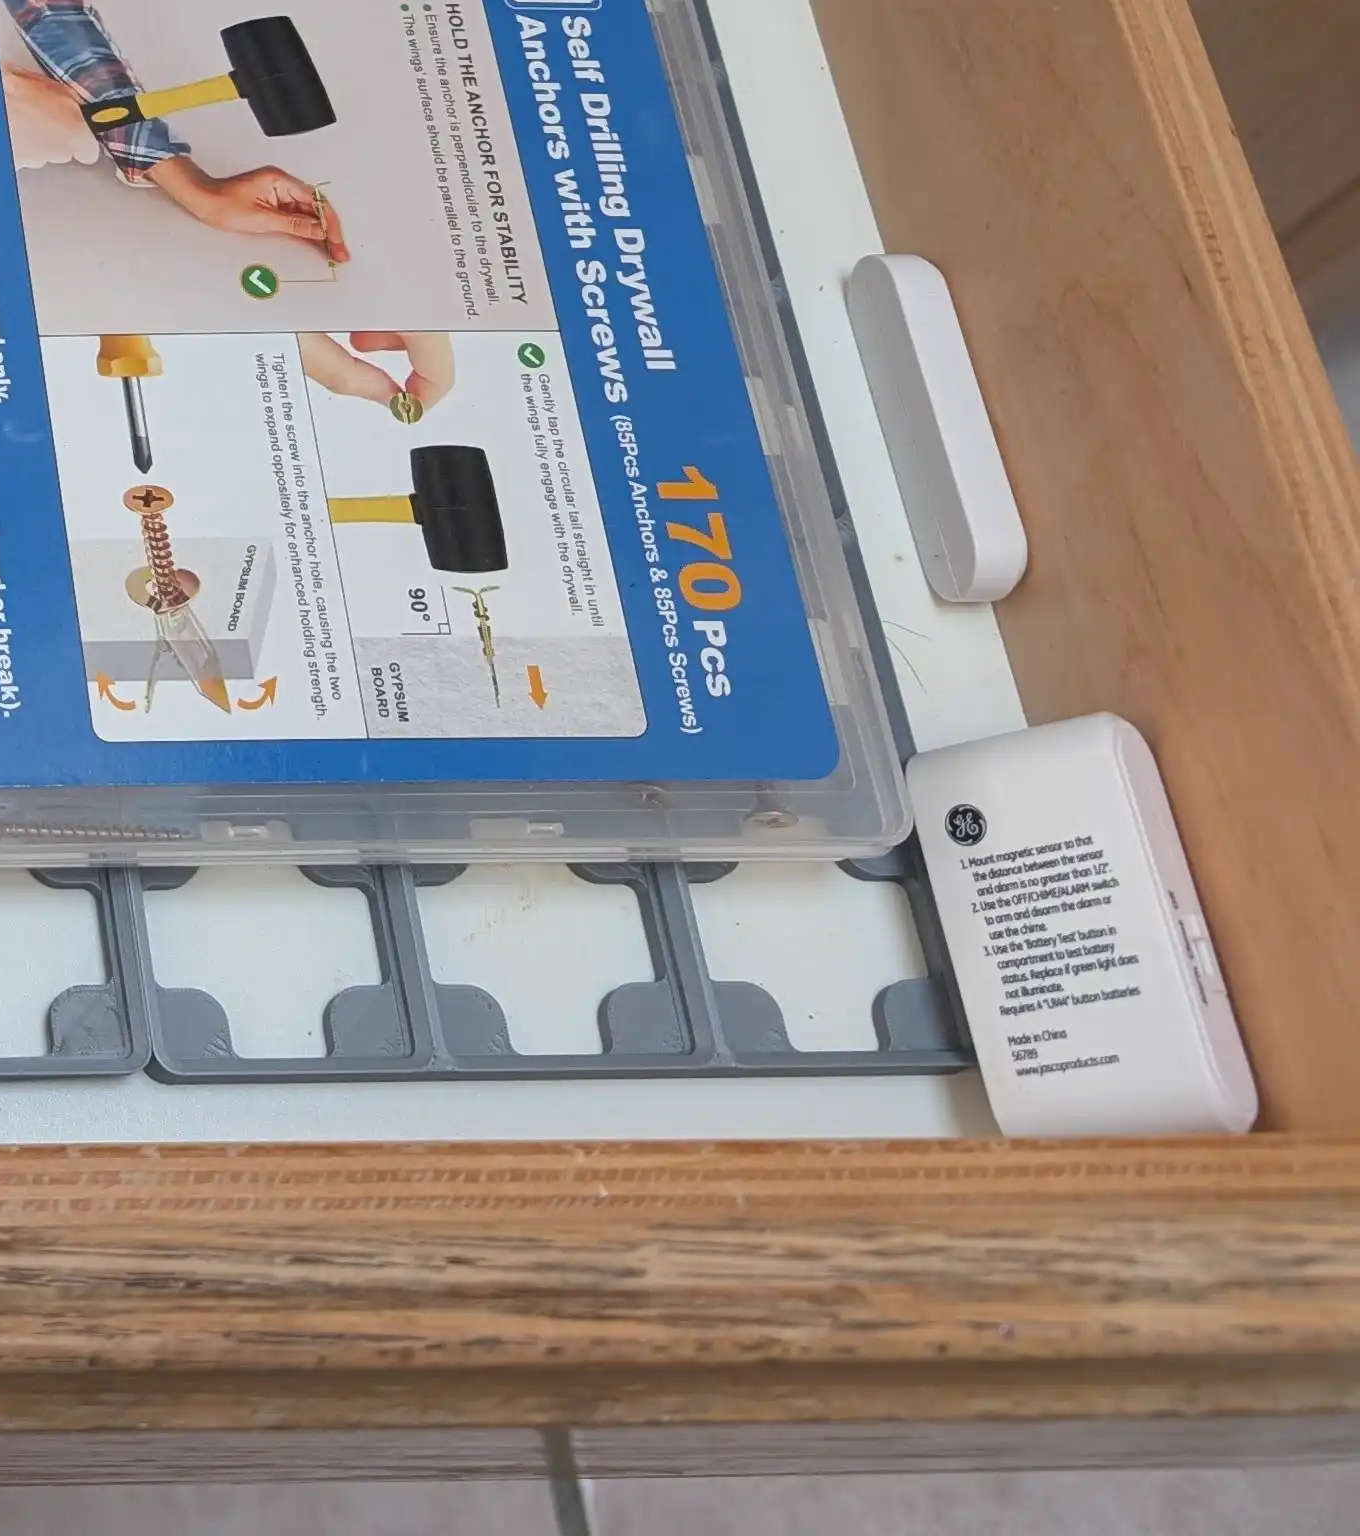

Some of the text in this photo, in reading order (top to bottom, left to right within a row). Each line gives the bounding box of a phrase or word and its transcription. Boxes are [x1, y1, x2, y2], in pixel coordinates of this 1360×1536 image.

[401, 12, 480, 321] The wings' surface should be parallel to the ground.
[423, 13, 500, 306] Ensure the anchor is perpendicular to the drywall.
[443, 2, 528, 305] HOLD THE ANCHOR FOR STABILITY
[514, 14, 627, 403] Anchors with Screws
[560, 15, 676, 370] Self Drilling Drywall
[253, 352, 328, 721] wings to expand oppositely for enhanced holding strength.
[269, 352, 342, 701] Tighten the screw into the anchor hole, causing the two
[519, 372, 584, 617] the wings fully engage with the drywall.
[536, 372, 605, 628] Gently tap the circular tail straight in until
[227, 544, 257, 632] GYPSUM BOARD
[406, 587, 431, 622] 90°
[607, 413, 703, 735] (85Pcs Anchors & 85Pcs Screws)
[658, 468, 740, 697] 170 Pcs
[369, 666, 390, 719] BOARD
[387, 661, 410, 723] GYPSUM
[967, 853, 996, 868] Mount
[995, 847, 1035, 863] magnetic
[1034, 841, 1062, 855] sensor
[1073, 835, 1093, 847] that
[972, 849, 1103, 882] the distance between the sensor
[979, 900, 996, 911] Use
[995, 896, 1011, 908] the
[1011, 881, 1090, 905] OFF/CHIME/ALARM
[1090, 877, 1119, 891] switch
[988, 922, 1046, 940] use the chime.
[1006, 1033, 1032, 1046] Made
[1041, 1029, 1067, 1041] China
[1011, 1047, 1038, 1061] 56789
[1015, 1054, 1120, 1076] www.jascoproducts.com
